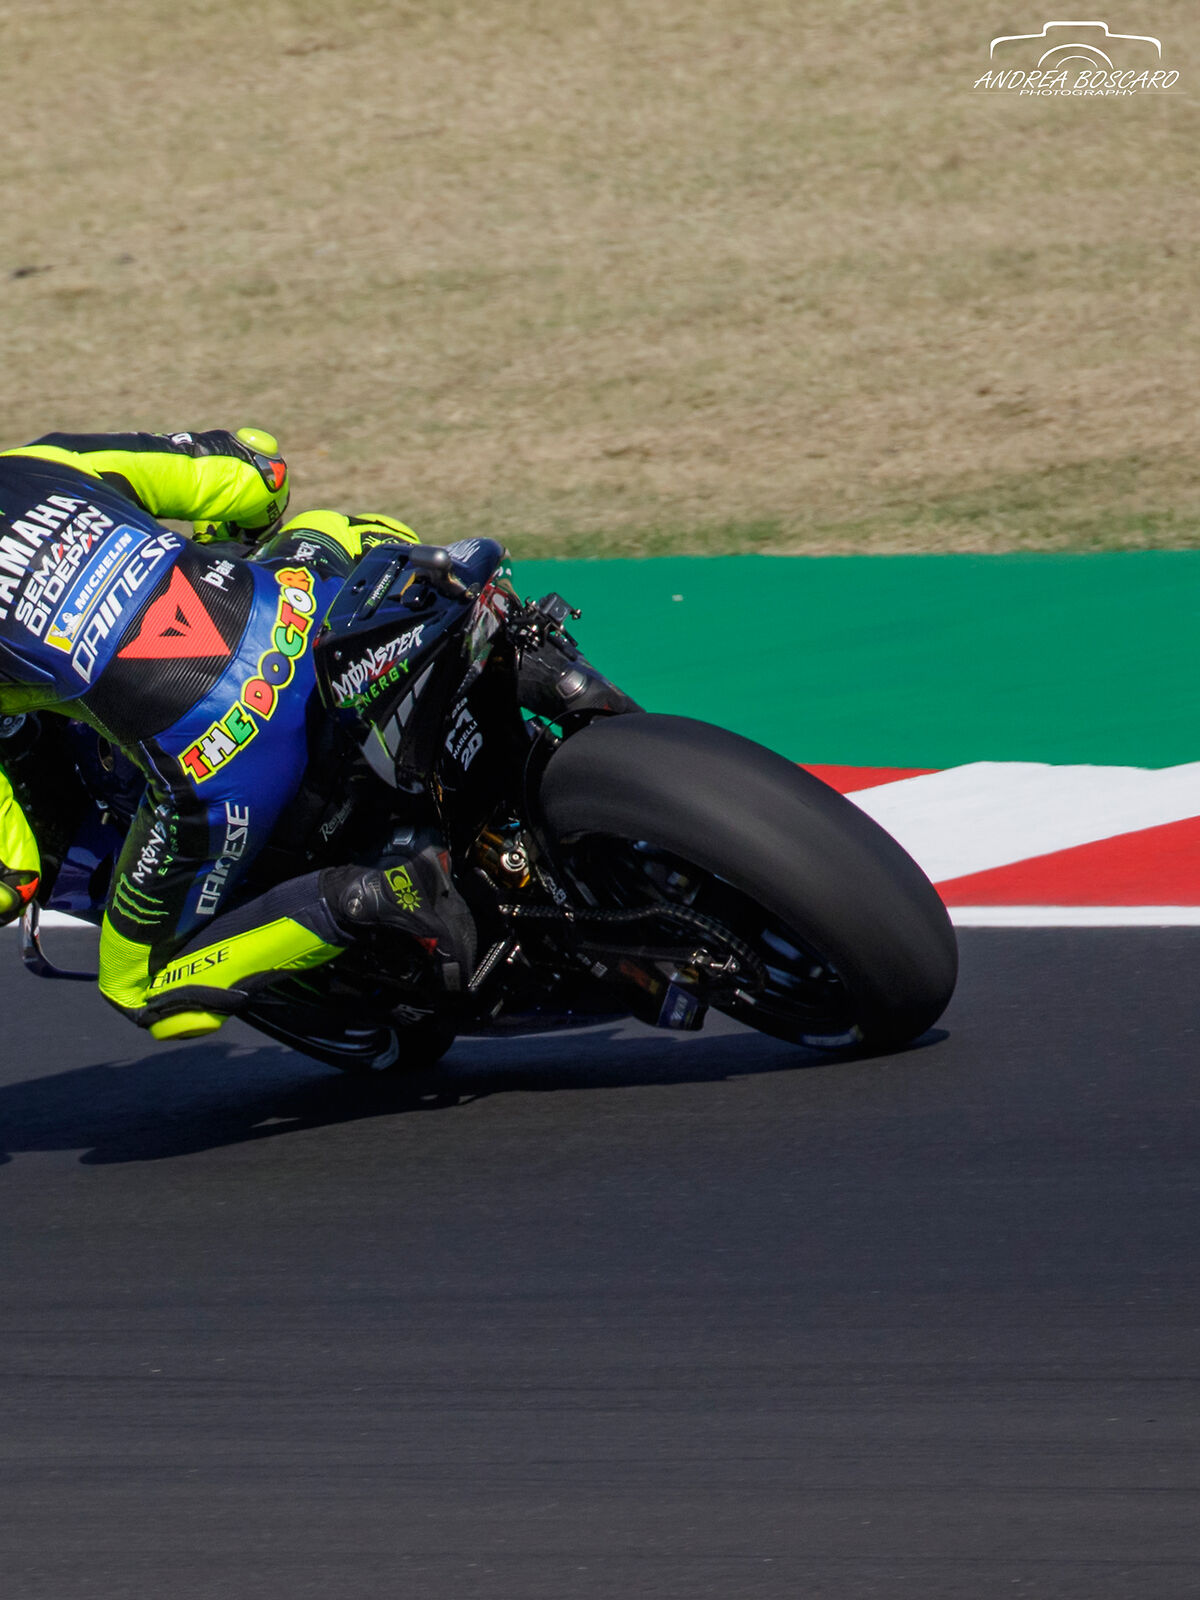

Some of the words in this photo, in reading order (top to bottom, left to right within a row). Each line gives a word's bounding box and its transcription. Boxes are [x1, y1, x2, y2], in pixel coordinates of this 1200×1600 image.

[42, 513, 115, 604] DEPAN
[73, 532, 133, 610] MICHELIN
[71, 531, 182, 684] DAINESE
[178, 701, 259, 784] THE
[241, 566, 318, 721] DOCTOR
[331, 623, 425, 704] MONSTER
[354, 658, 411, 715] ENERGY
[452, 720, 479, 760] MARELLI
[460, 732, 484, 772] 2D
